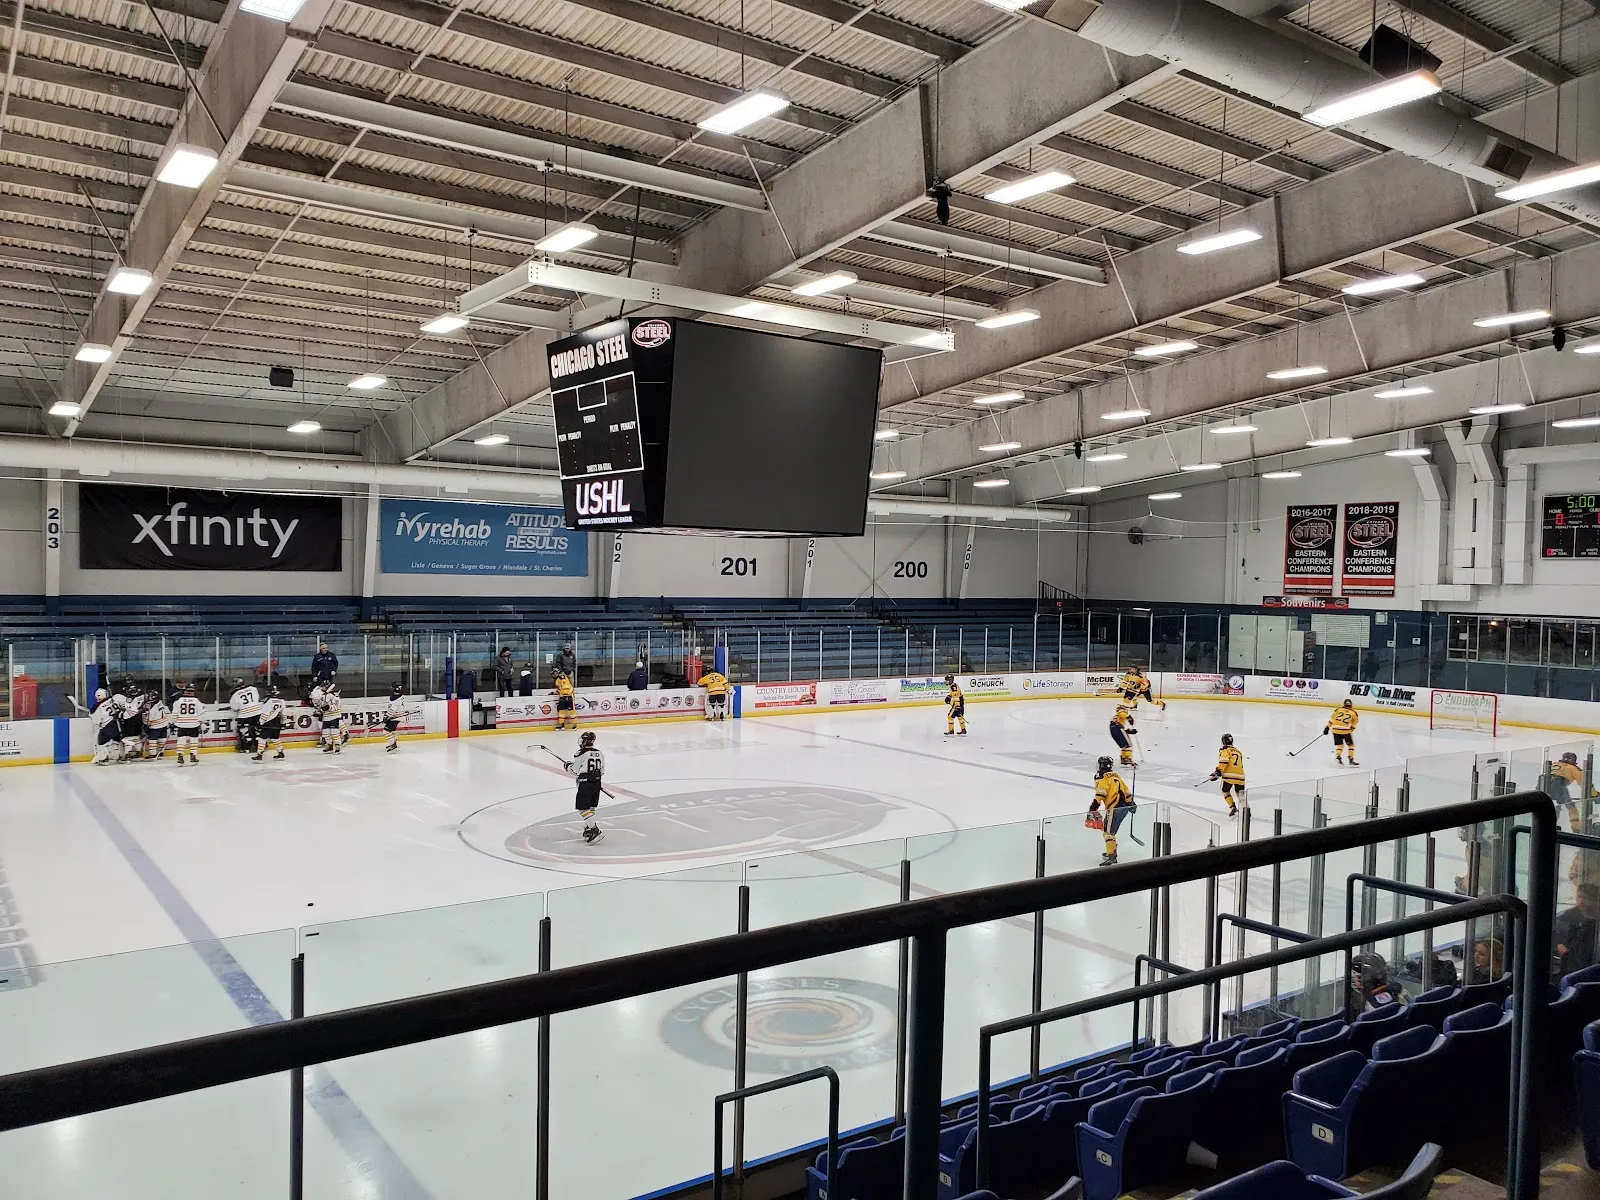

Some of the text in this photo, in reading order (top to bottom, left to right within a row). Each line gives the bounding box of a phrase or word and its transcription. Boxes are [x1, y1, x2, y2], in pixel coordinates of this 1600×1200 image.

[637, 327, 670, 338] STEEL
[551, 334, 629, 378] CHICAGO STEEL
[576, 480, 630, 515] USHL
[1567, 496, 1595, 508] 5:00
[1292, 508, 1332, 517] 2016-2017
[1348, 505, 1395, 515] 2018-2019
[48, 508, 59, 549] 203
[131, 502, 299, 558] xfinity
[396, 512, 491, 543] ivyrehab
[1294, 525, 1331, 538] STEEL
[1353, 523, 1391, 538] STEEL
[428, 538, 489, 547] PHYSICAL THERAPY
[505, 535, 568, 550] RESULTS
[1353, 549, 1387, 557] EASTERN
[721, 557, 758, 577] 201
[1345, 557, 1395, 565] CONFERENCE
[894, 561, 928, 579] 200
[1290, 565, 1331, 573] CHAMPIONS
[1347, 565, 1392, 573] CHAMPIONS
[1281, 597, 1326, 608] Souvenirs
[1032, 680, 1074, 689] LifeStorage
[240, 692, 254, 704] 37
[1392, 687, 1416, 700] River
[180, 703, 195, 715] 86
[1336, 711, 1351, 723] 22
[588, 759, 601, 773] 60
[1318, 1128, 1327, 1139] D
[1101, 1153, 1107, 1163] C
